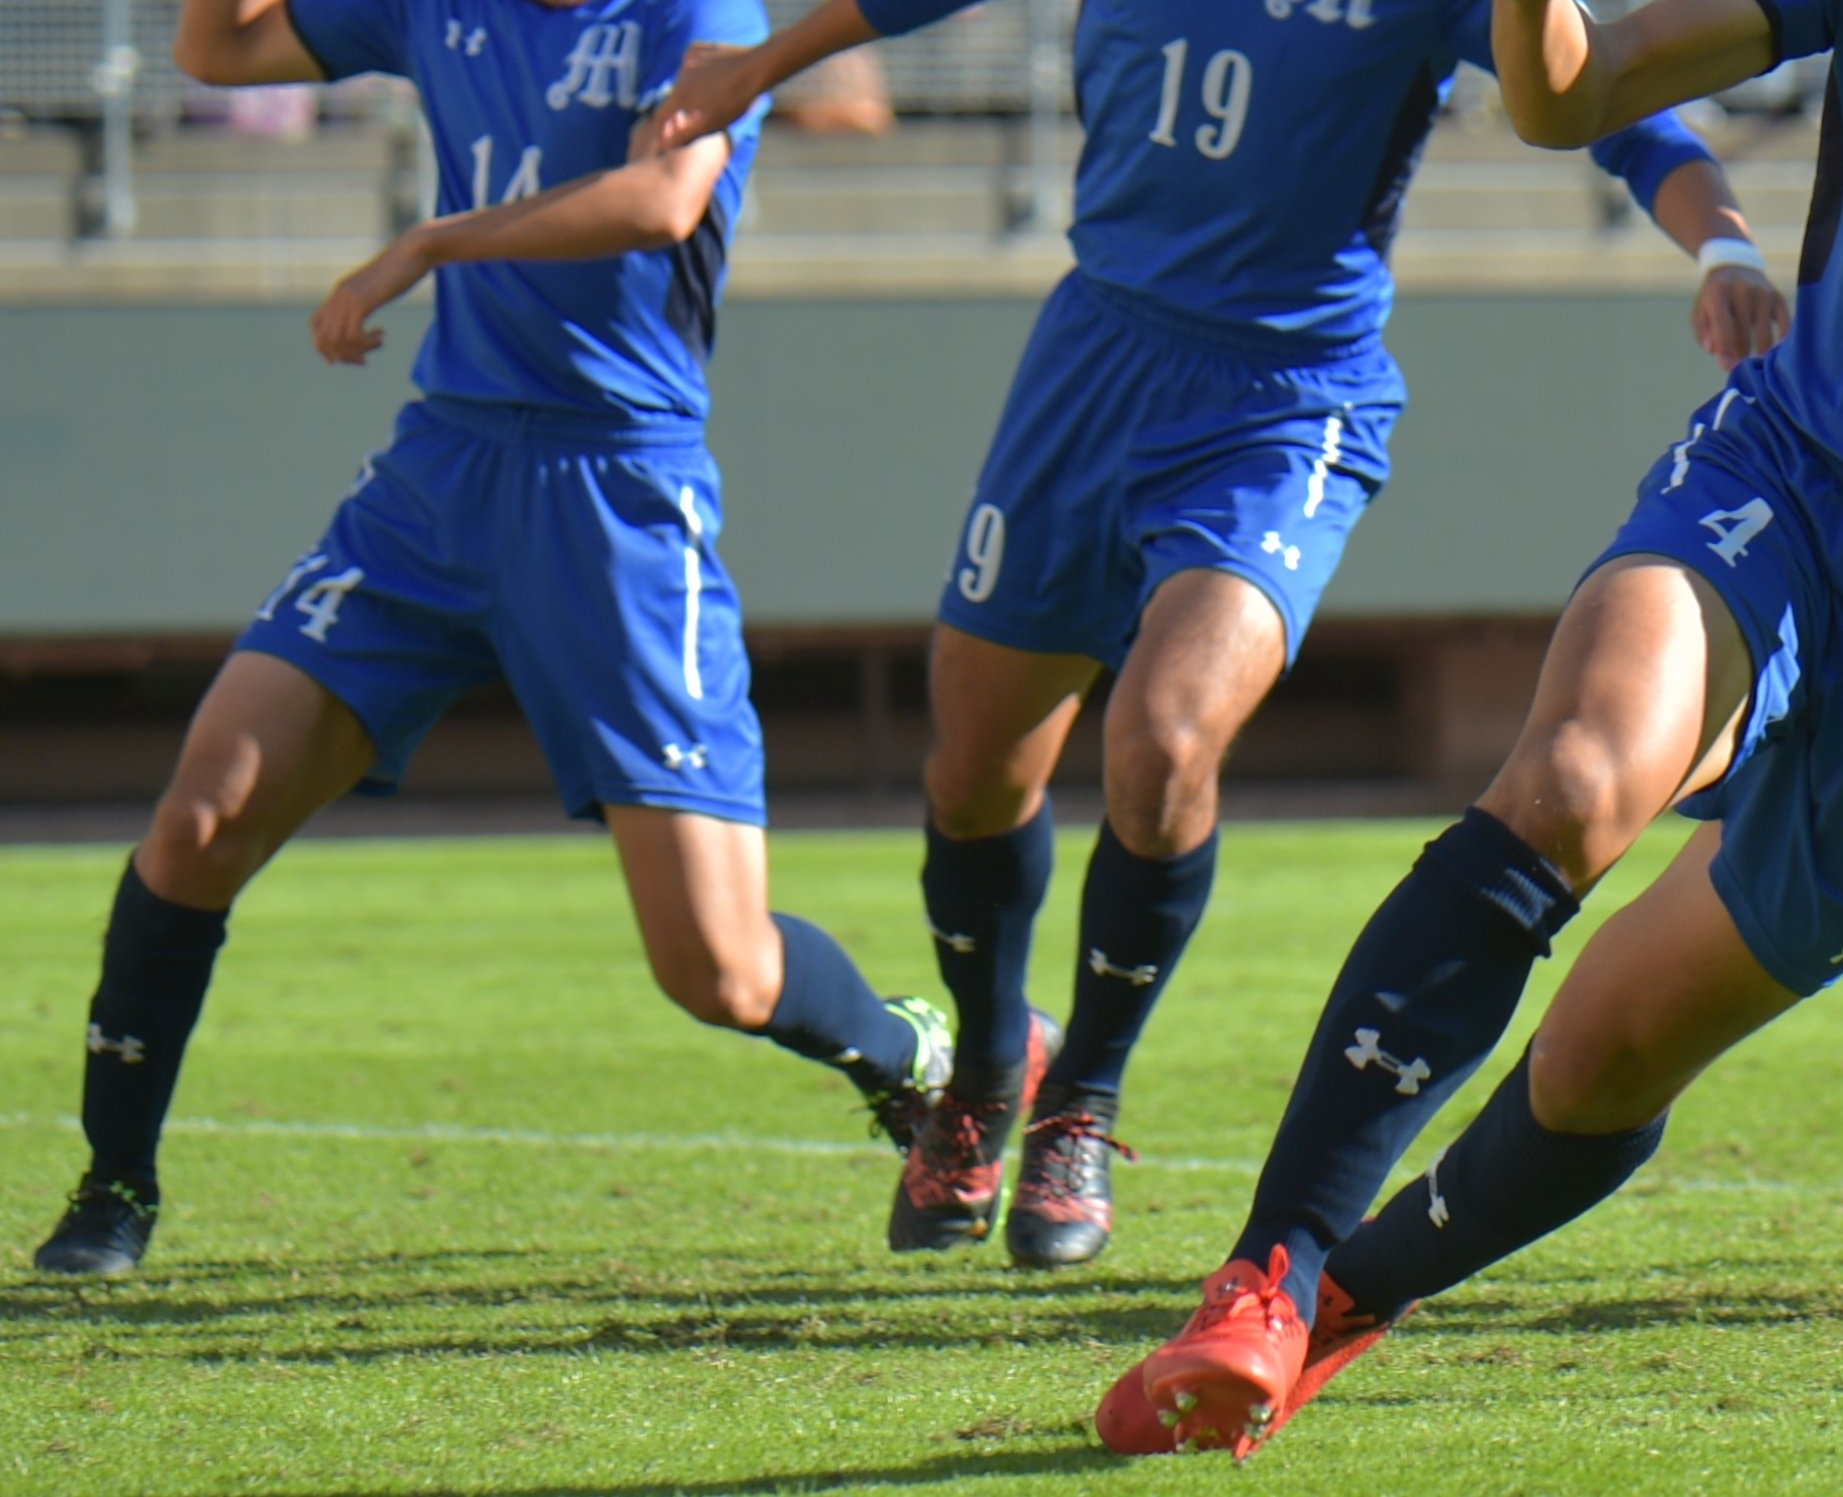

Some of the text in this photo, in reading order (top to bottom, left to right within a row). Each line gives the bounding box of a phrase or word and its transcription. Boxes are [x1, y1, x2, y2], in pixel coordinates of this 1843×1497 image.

[1149, 37, 1254, 159] 19
[1698, 497, 1774, 568] 4
[256, 554, 364, 642] 14
